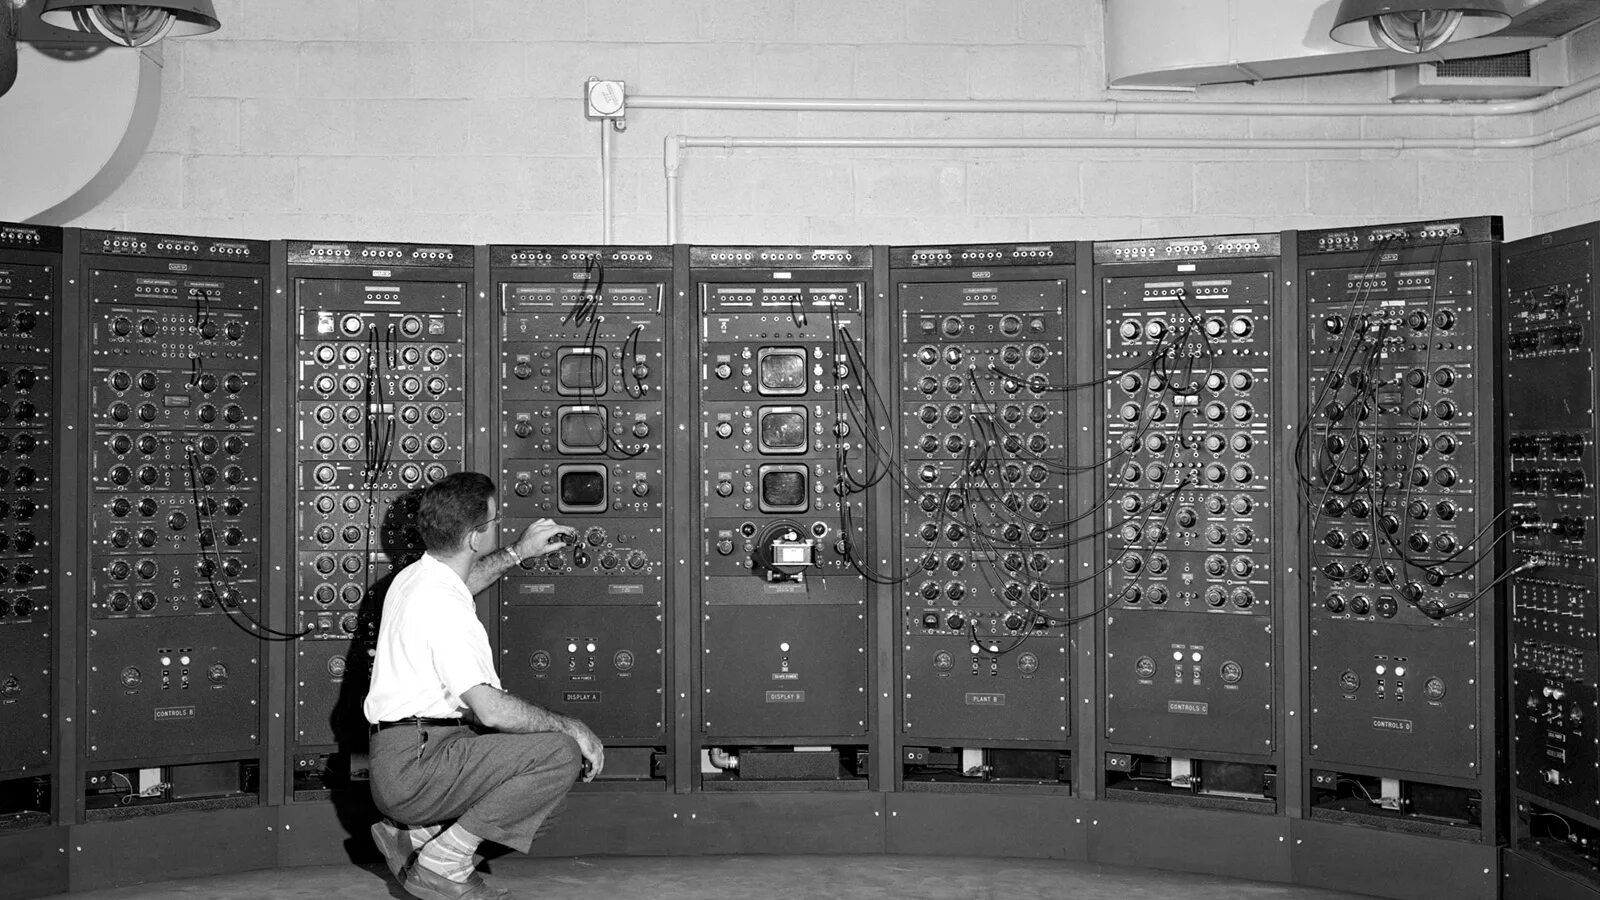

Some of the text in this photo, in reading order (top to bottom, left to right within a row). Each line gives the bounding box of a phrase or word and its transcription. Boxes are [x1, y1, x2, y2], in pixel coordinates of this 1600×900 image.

[1170, 703, 1200, 712] CONTROLS
[156, 709, 187, 717] CONTROLS
[1373, 720, 1404, 729] CONTROLS
